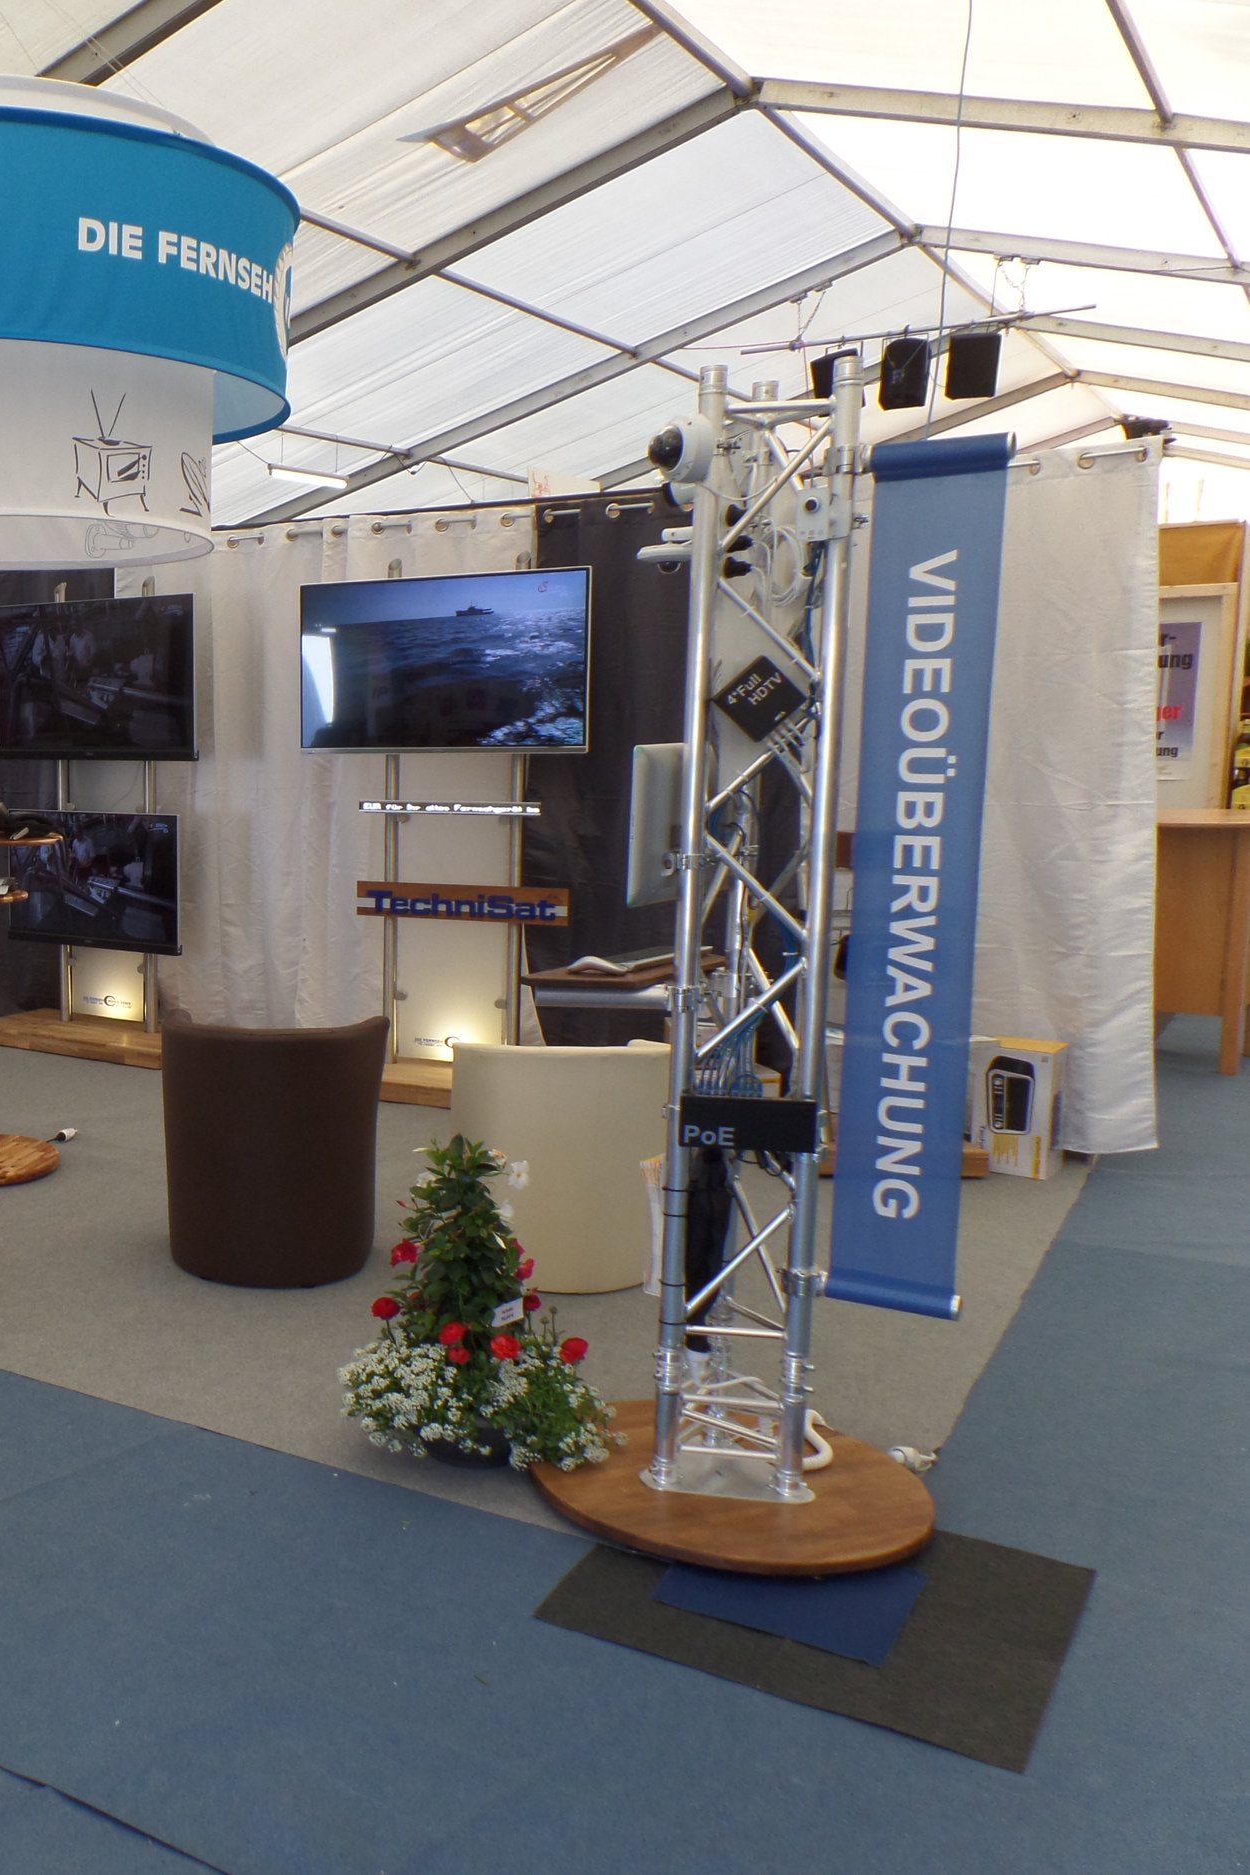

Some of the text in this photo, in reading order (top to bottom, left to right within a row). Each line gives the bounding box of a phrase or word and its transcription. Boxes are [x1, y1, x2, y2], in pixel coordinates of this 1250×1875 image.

[78, 217, 274, 304] DIE FERNSEH
[748, 672, 783, 705] HDTV
[873, 549, 958, 1219] VIDEOÜBERWACHUNG
[366, 890, 556, 921] TechniSat
[683, 1125, 734, 1146] PoE
